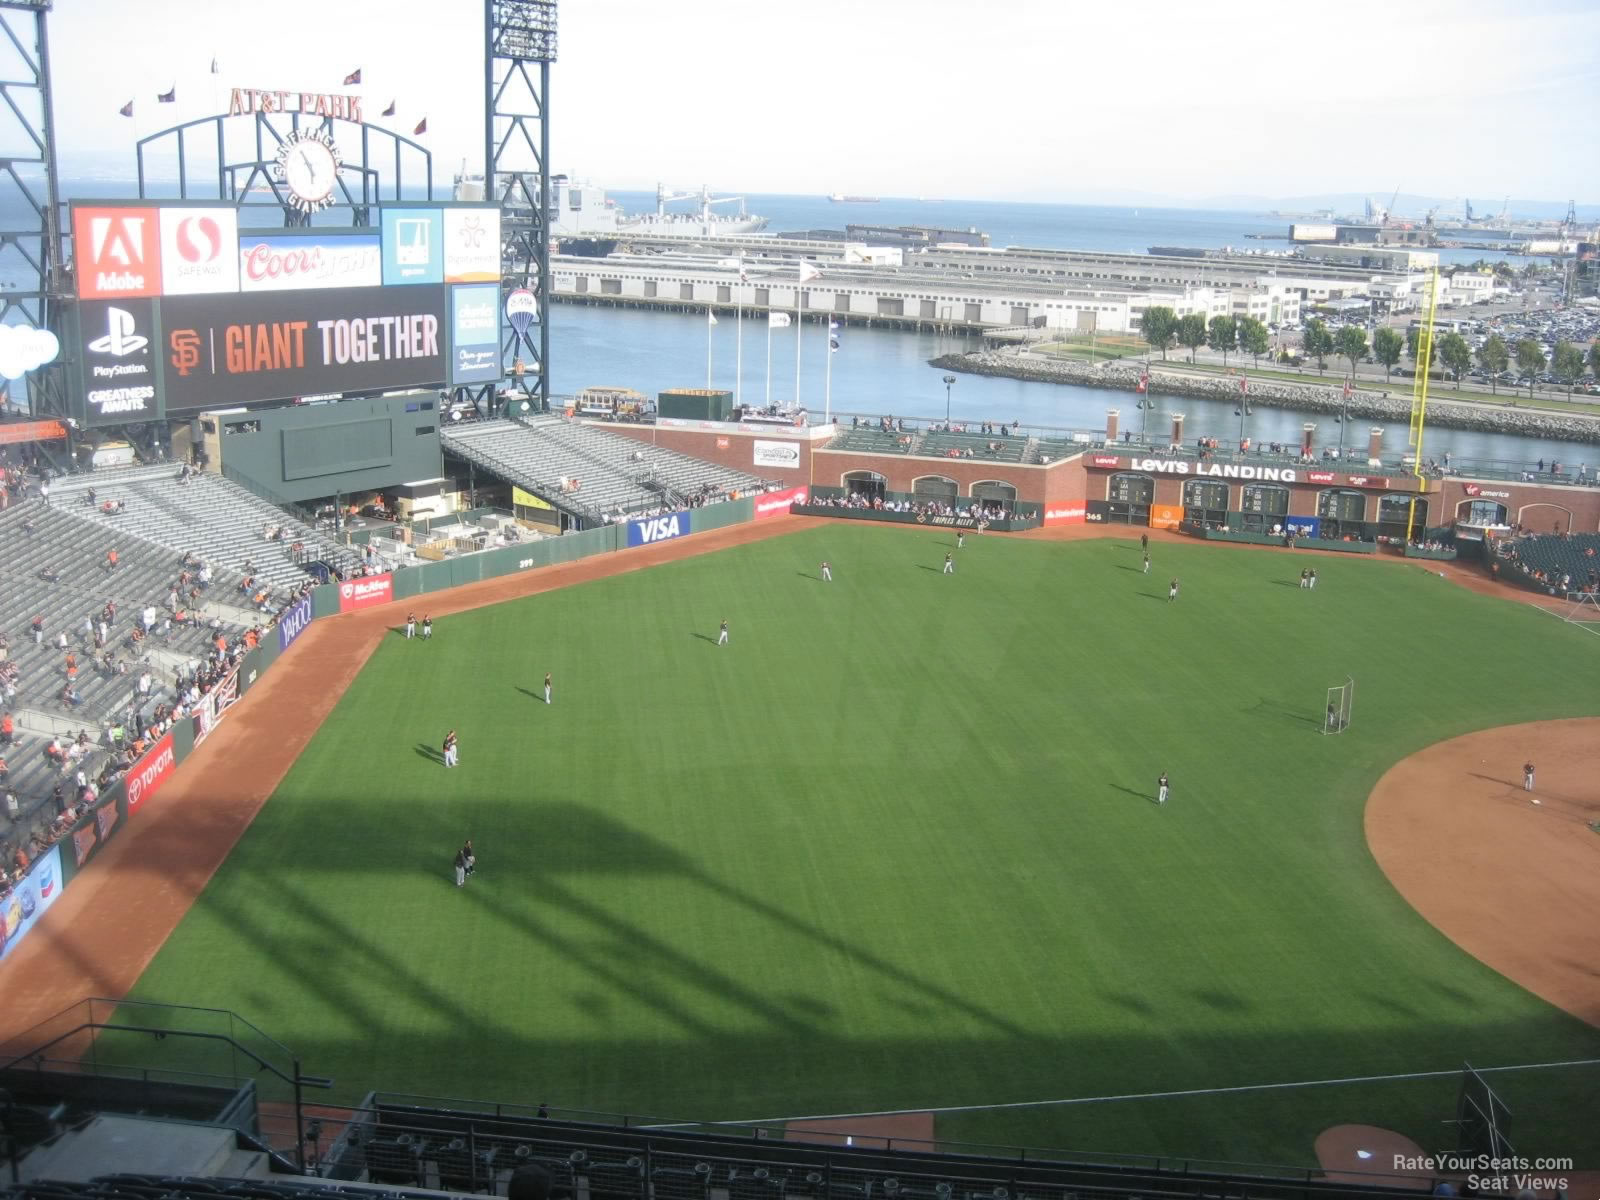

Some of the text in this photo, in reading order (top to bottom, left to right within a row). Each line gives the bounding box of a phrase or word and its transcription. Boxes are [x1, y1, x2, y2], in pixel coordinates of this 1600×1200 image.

[229, 88, 362, 124] AT&T PARK
[287, 192, 337, 214] GIANTS
[177, 264, 225, 277] SAFEWAY
[243, 243, 321, 281] Coors
[95, 272, 145, 291] Adobe
[225, 321, 308, 374] GIANT
[317, 314, 439, 366] TOGETHER
[88, 386, 154, 403] GREATNESS
[1196, 463, 1296, 482] LANDING
[1479, 490, 1510, 498] america
[932, 515, 974, 526] TRIPLES ALLEY
[1086, 512, 1102, 521] 365
[637, 516, 680, 543] VISA
[519, 559, 534, 569] 399
[354, 580, 390, 595] McAfee
[282, 594, 312, 646] YAHOO!
[141, 747, 174, 789] TOYOTA
